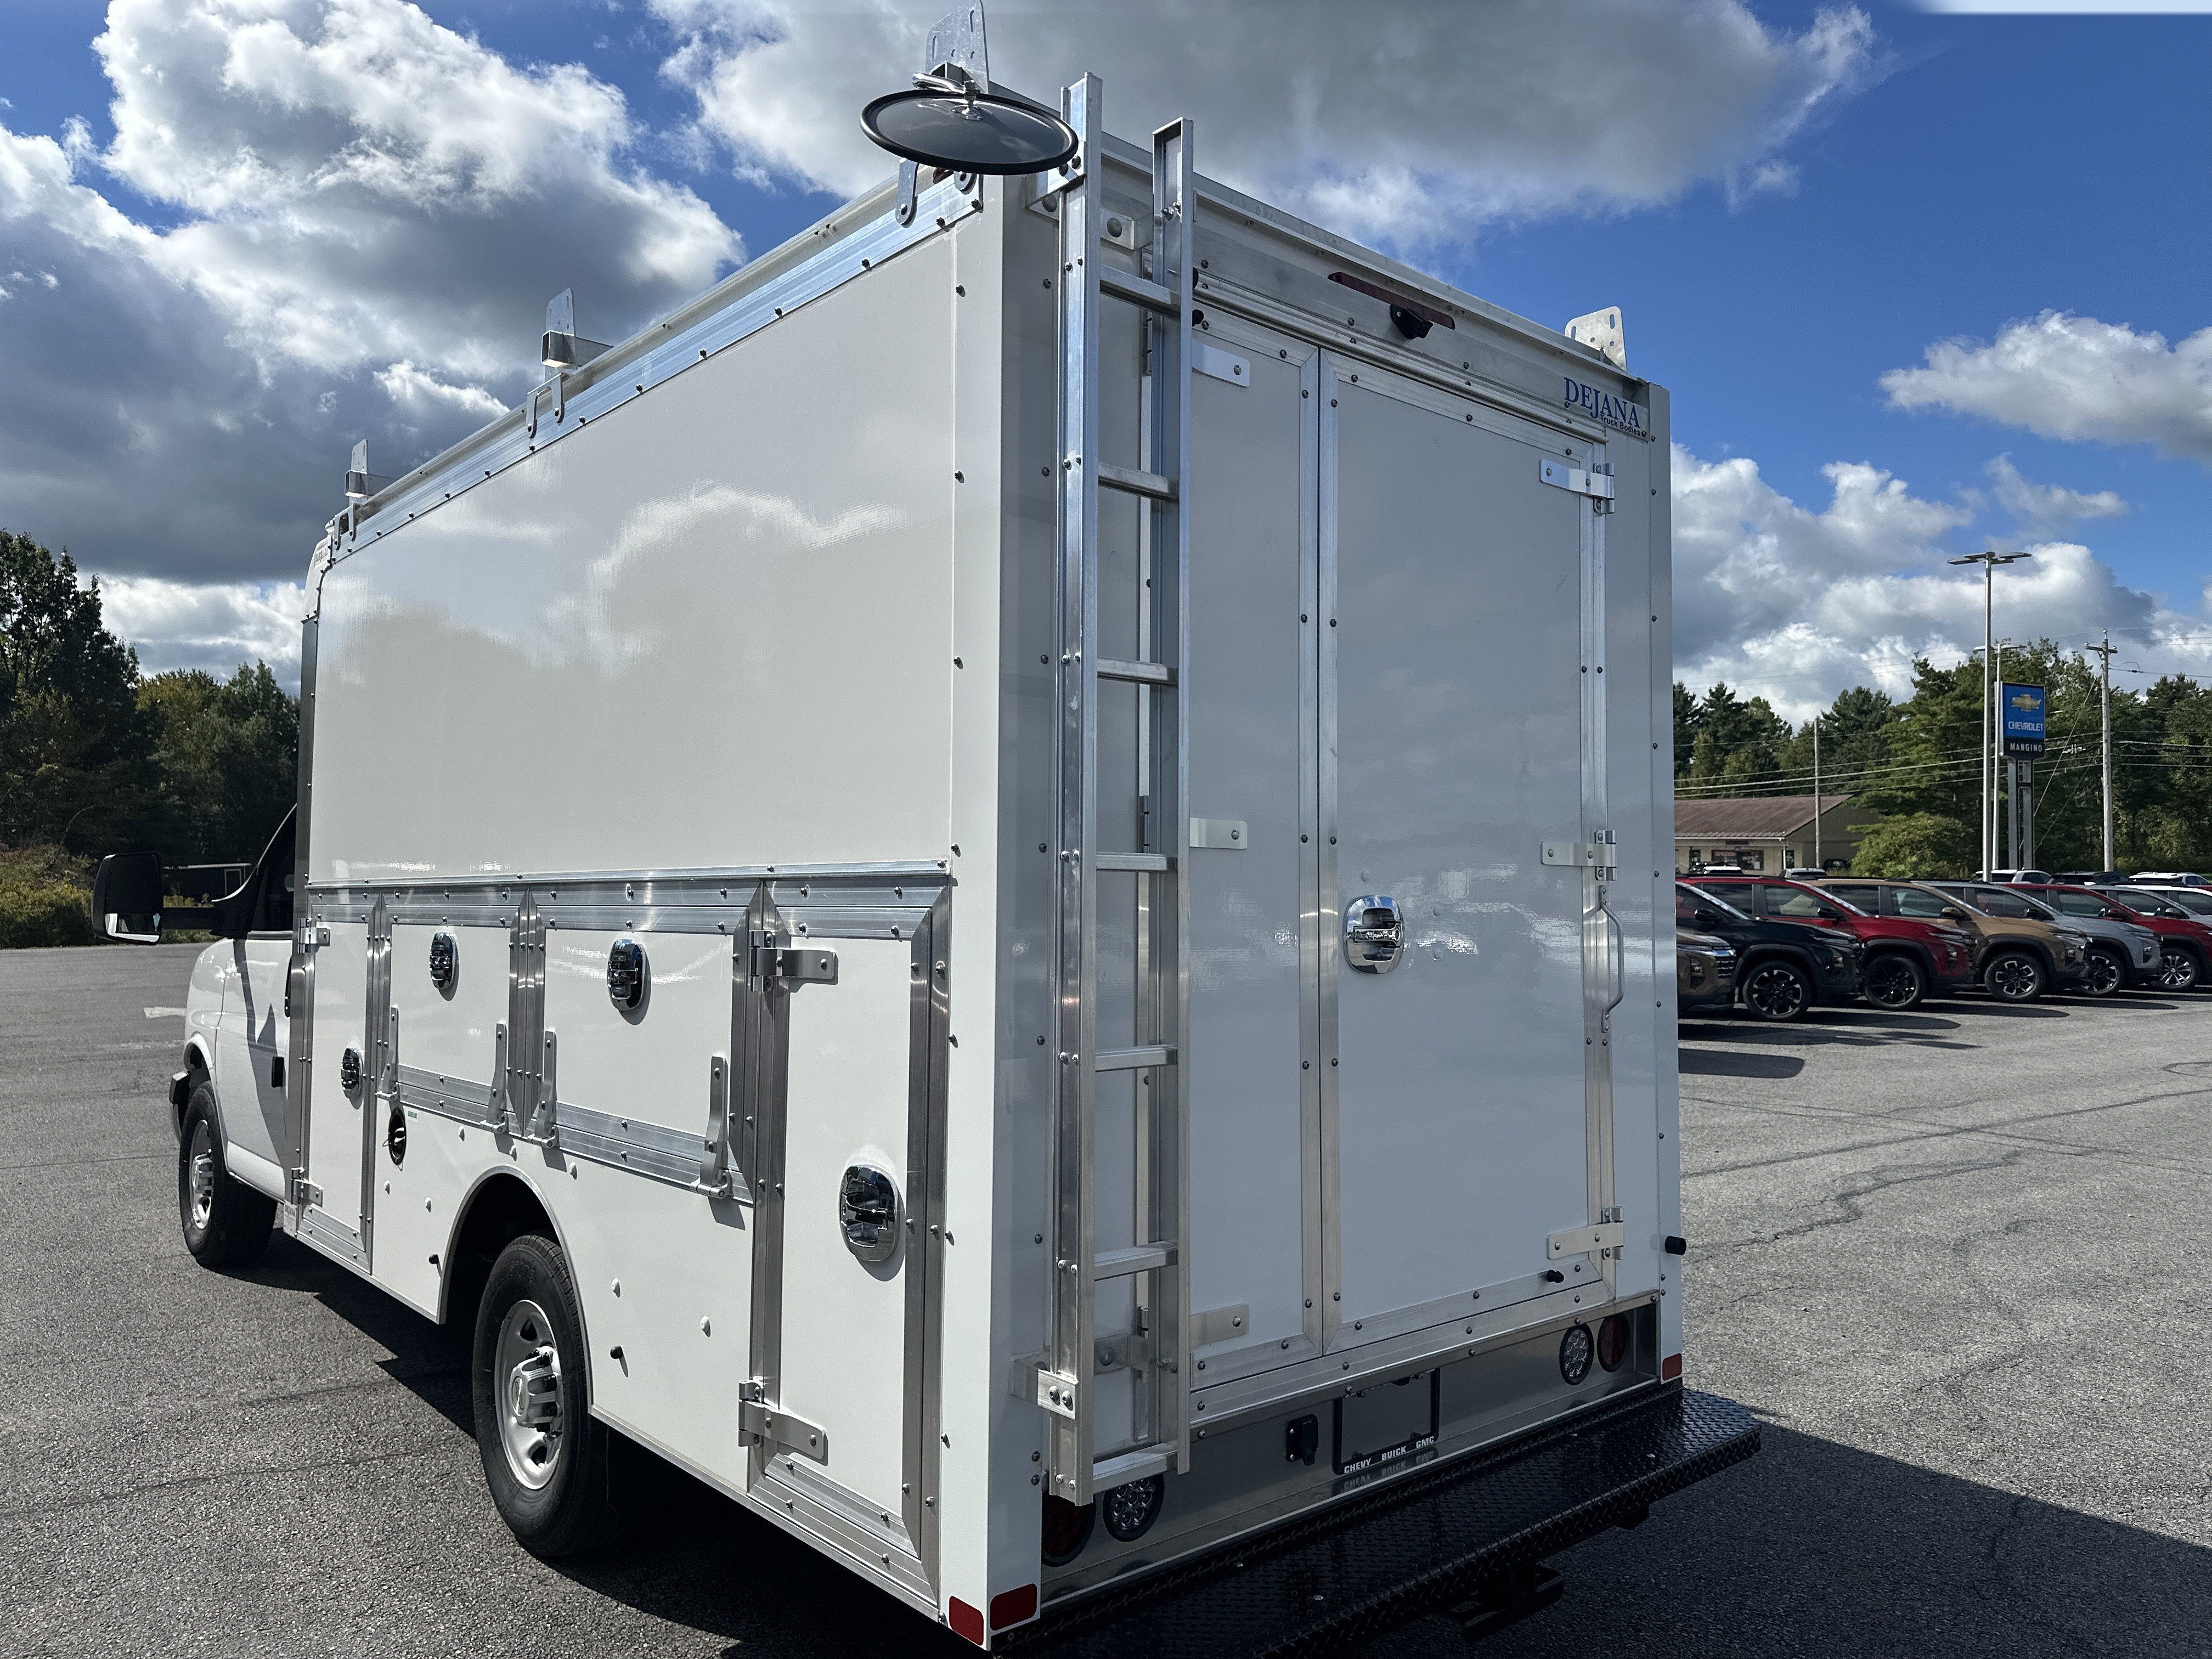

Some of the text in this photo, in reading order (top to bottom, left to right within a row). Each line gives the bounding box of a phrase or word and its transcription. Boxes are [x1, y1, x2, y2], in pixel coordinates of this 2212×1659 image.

[1564, 377, 1640, 428] DEJANA
[1600, 414, 1640, 436] Truck Bodies
[2008, 721, 2044, 731] CHEVROLET
[2010, 742, 2042, 752] MANGINO
[1344, 1436, 1435, 1474] CHEVY BUICK GMC
